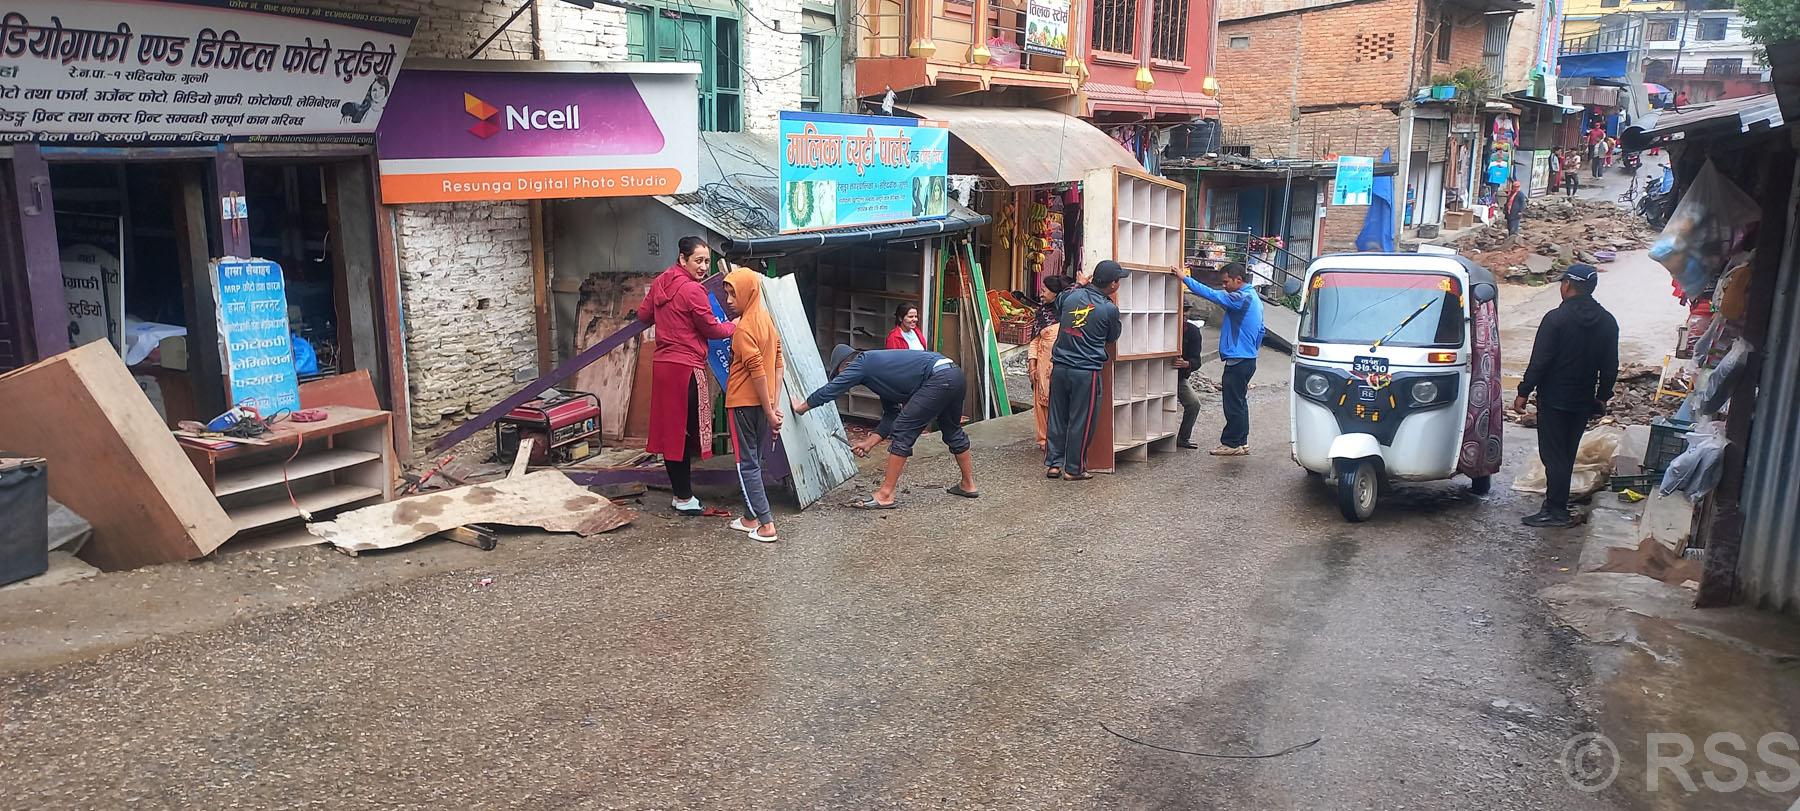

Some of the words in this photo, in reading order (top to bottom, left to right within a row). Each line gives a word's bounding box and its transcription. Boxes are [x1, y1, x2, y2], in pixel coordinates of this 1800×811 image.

[1029, 0, 1050, 18] तिलक
[0, 11, 133, 66] डियोग्राफी
[137, 34, 190, 66] एण्ड
[191, 27, 280, 72] डिजिटल
[282, 37, 332, 75] फोटो
[334, 41, 397, 83] स्टुडियो
[24, 87, 51, 101] तथा
[94, 88, 135, 102] अर्जेन्ट
[296, 95, 341, 109] लेमिनेशन
[32, 109, 65, 123] प्रिन्ट
[67, 111, 95, 123] तथा
[97, 111, 132, 123] कलर
[134, 110, 163, 124] प्रिन्ट
[210, 113, 245, 127] सम्पूर्ण
[246, 115, 269, 126] काम
[271, 114, 306, 126] गरिन्छ
[506, 104, 580, 131] Ncell
[104, 131, 148, 145] सम्पूर्ण
[150, 132, 177, 142] काम
[180, 131, 223, 143] गरिन्छ
[786, 122, 842, 168] मालिका
[879, 129, 912, 168] पार्लर
[442, 179, 511, 194] Resunga
[518, 177, 568, 191] Digital
[573, 176, 615, 189] Photo
[620, 175, 667, 188] Studio
[224, 285, 241, 294] MRP
[231, 336, 286, 352] फोटोकपी
[233, 354, 291, 370] लेमिनेशन
[1361, 390, 1375, 398] RE
